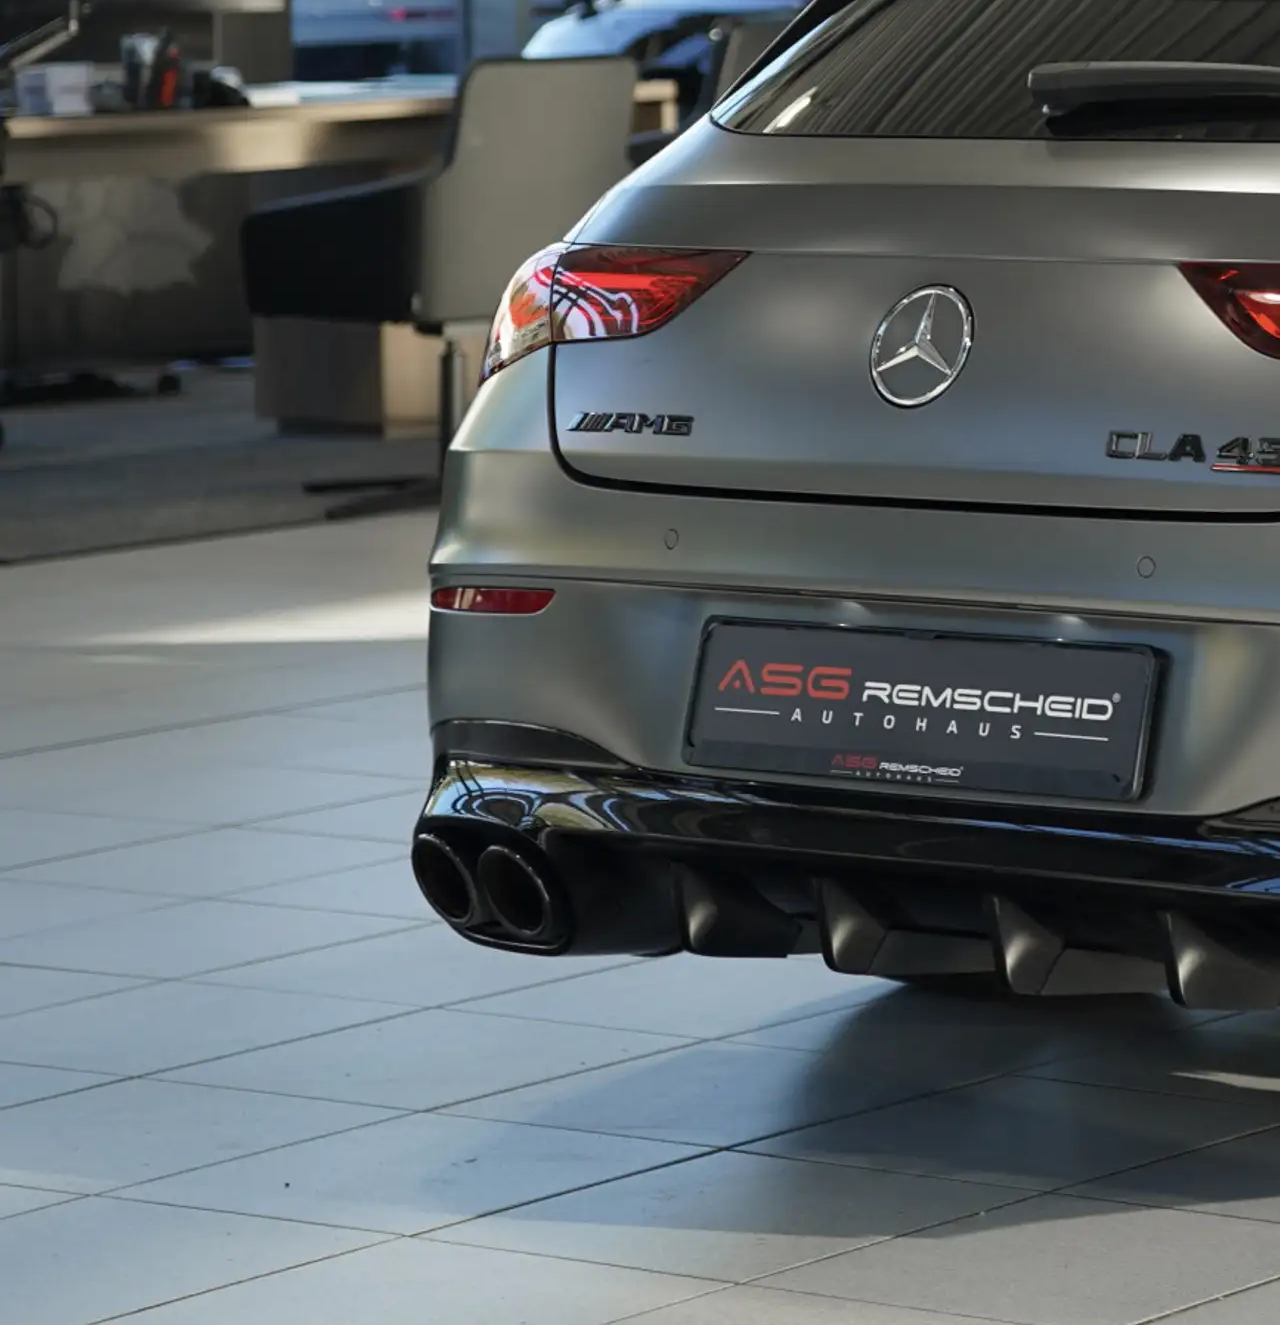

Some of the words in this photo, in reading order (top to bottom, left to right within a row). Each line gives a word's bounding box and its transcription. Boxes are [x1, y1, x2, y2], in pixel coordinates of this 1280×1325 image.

[1105, 431, 1206, 463] CLA
[718, 659, 852, 701] ASG
[790, 707, 1023, 740] AUTOHAUS
[830, 754, 877, 770] ASG
